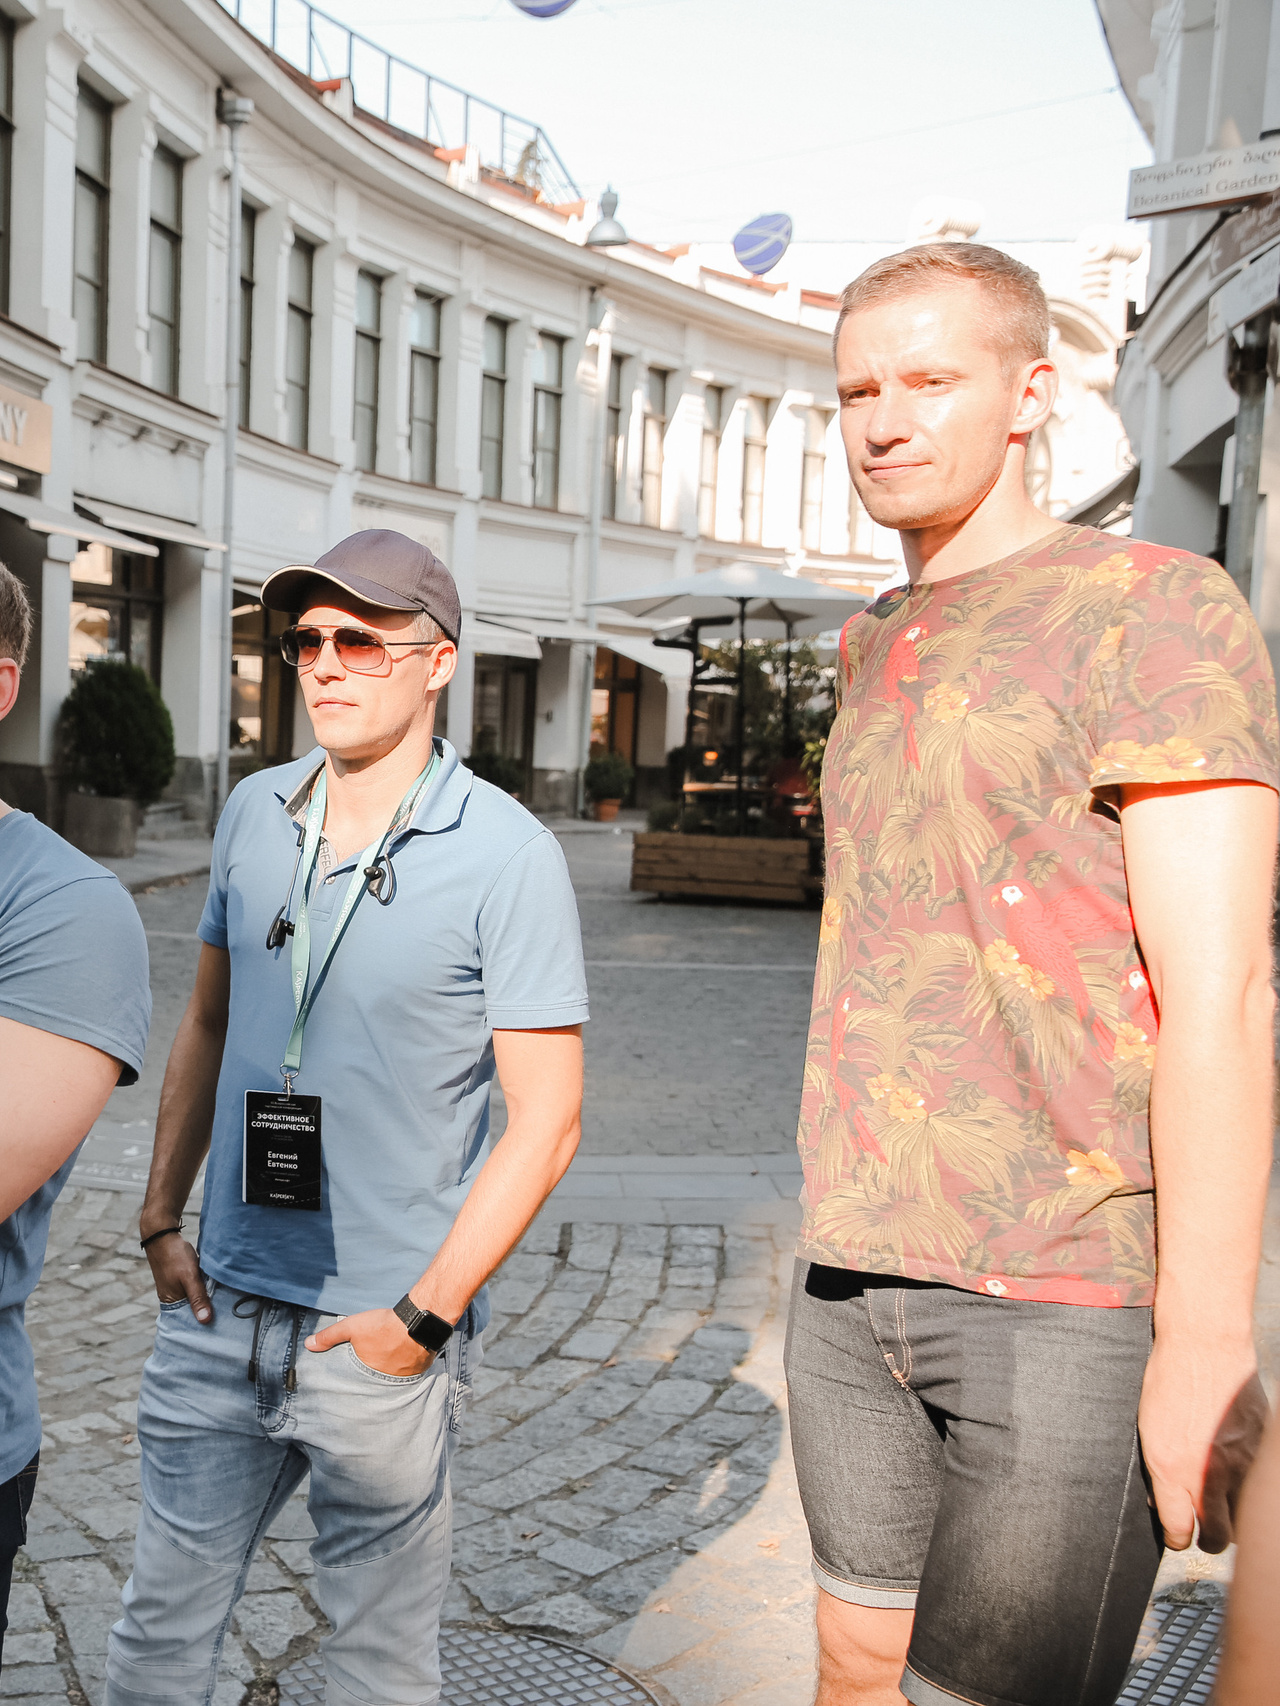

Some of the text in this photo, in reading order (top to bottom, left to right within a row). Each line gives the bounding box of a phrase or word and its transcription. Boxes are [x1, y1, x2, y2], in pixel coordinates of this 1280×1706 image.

[1133, 173, 1279, 208] Botanical Garden
[257, 1112, 310, 1124] ЭФФЕКТИВНОЕ
[251, 1120, 316, 1132] СОТРУДНИЧЕСТВО
[267, 1150, 298, 1161] Евгений
[267, 1159, 298, 1170] Евтенко
